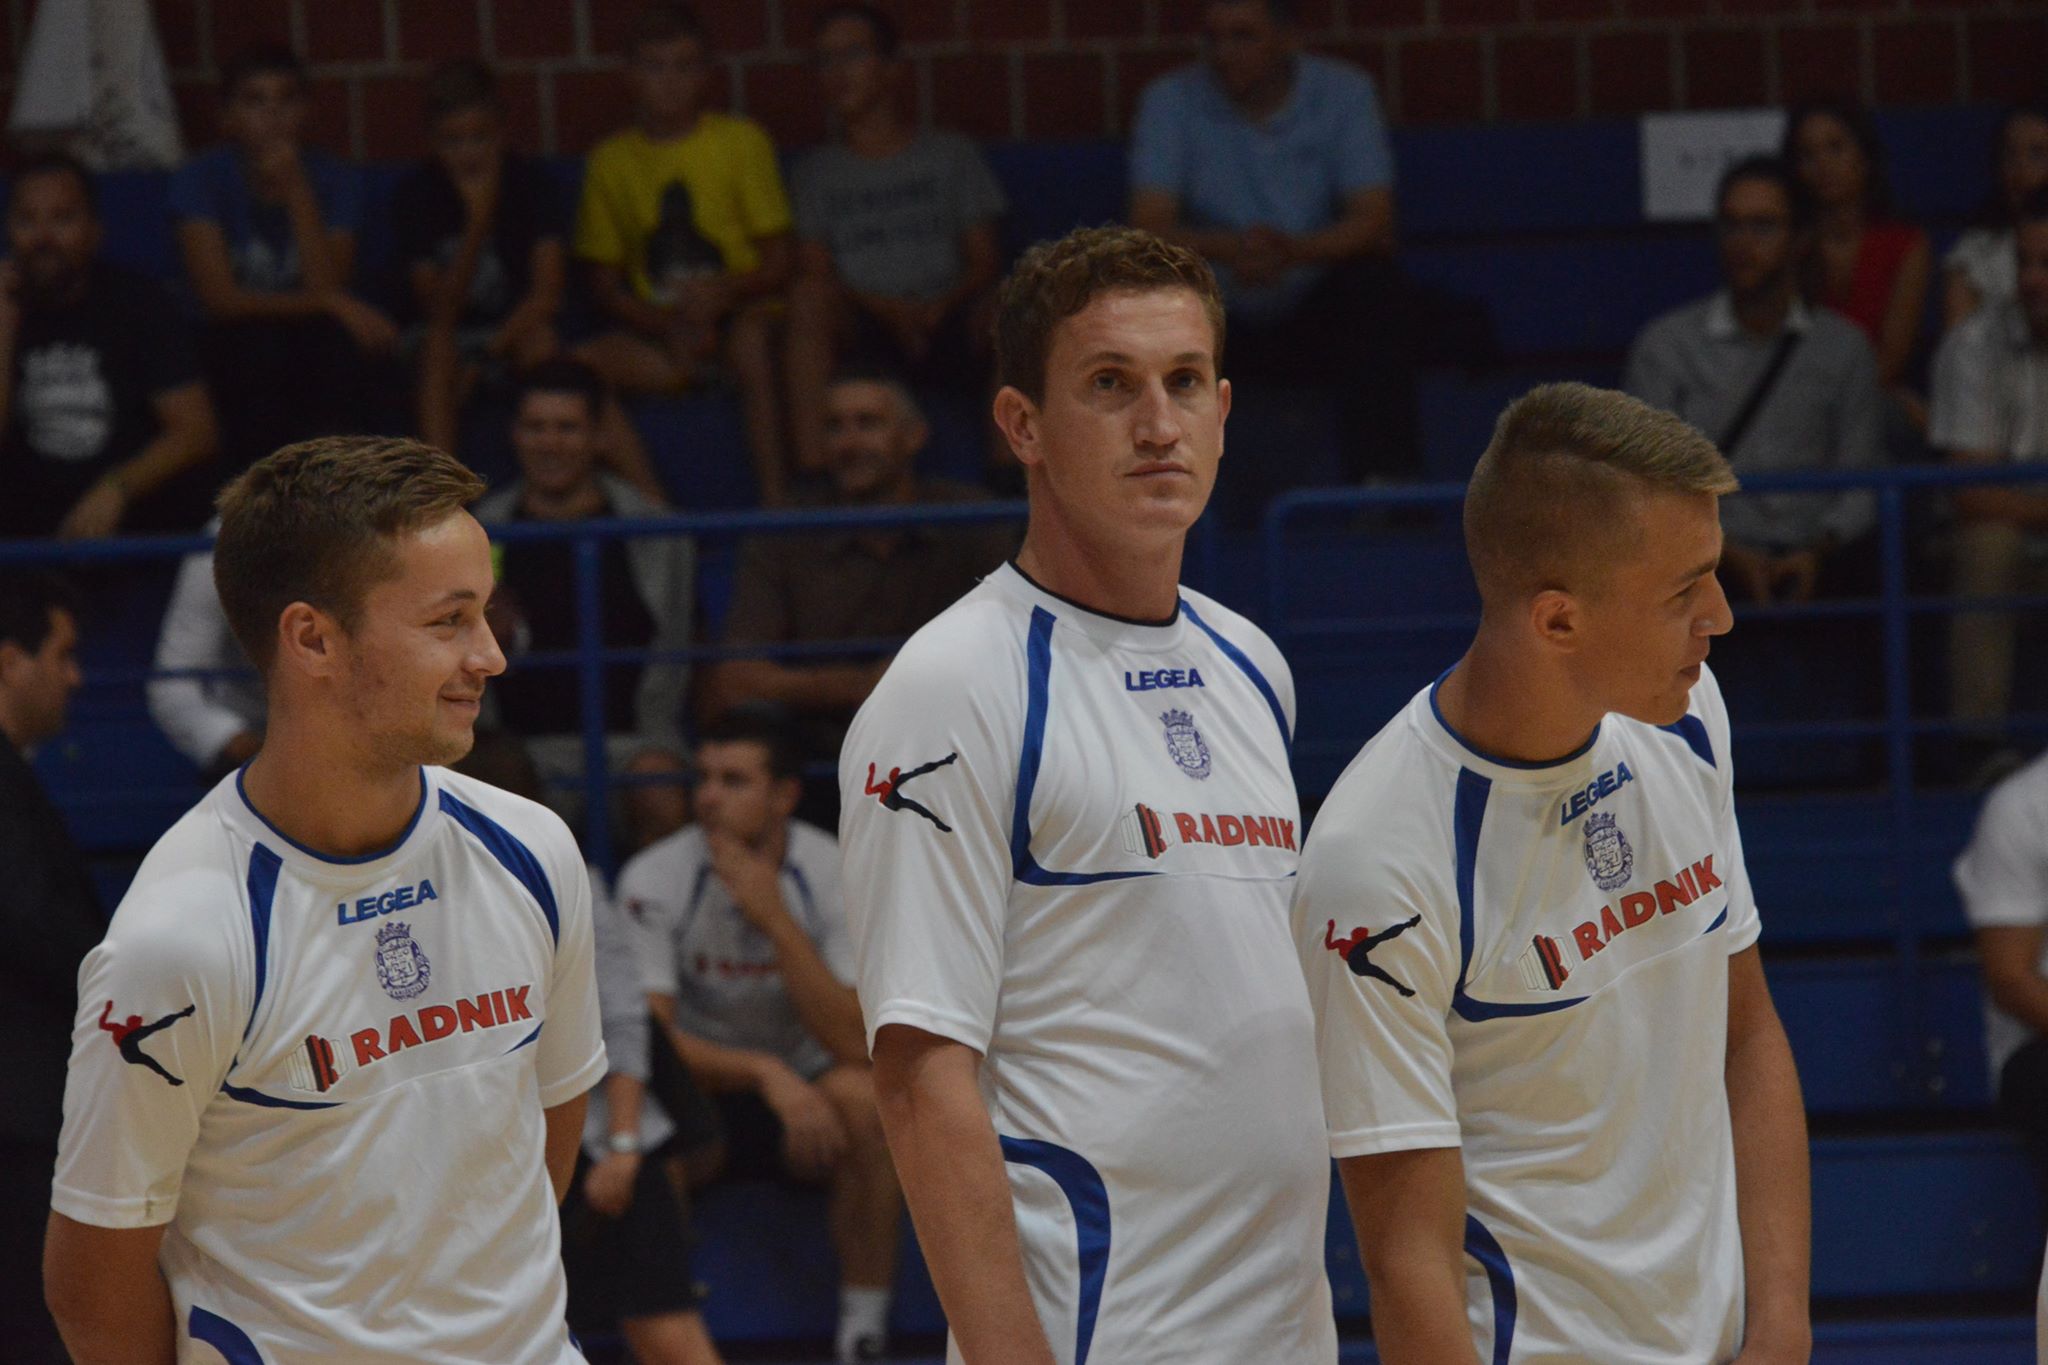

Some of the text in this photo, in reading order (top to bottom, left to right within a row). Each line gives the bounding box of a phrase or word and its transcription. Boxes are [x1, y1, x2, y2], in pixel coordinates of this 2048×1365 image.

[1124, 668, 1205, 691] LEGEA
[1561, 761, 1634, 826] LEGEA
[1173, 812, 1297, 852] RADNIK
[338, 879, 438, 926] LEGEA
[1572, 854, 1722, 961] RADNIK
[350, 984, 534, 1067] RADNIK
